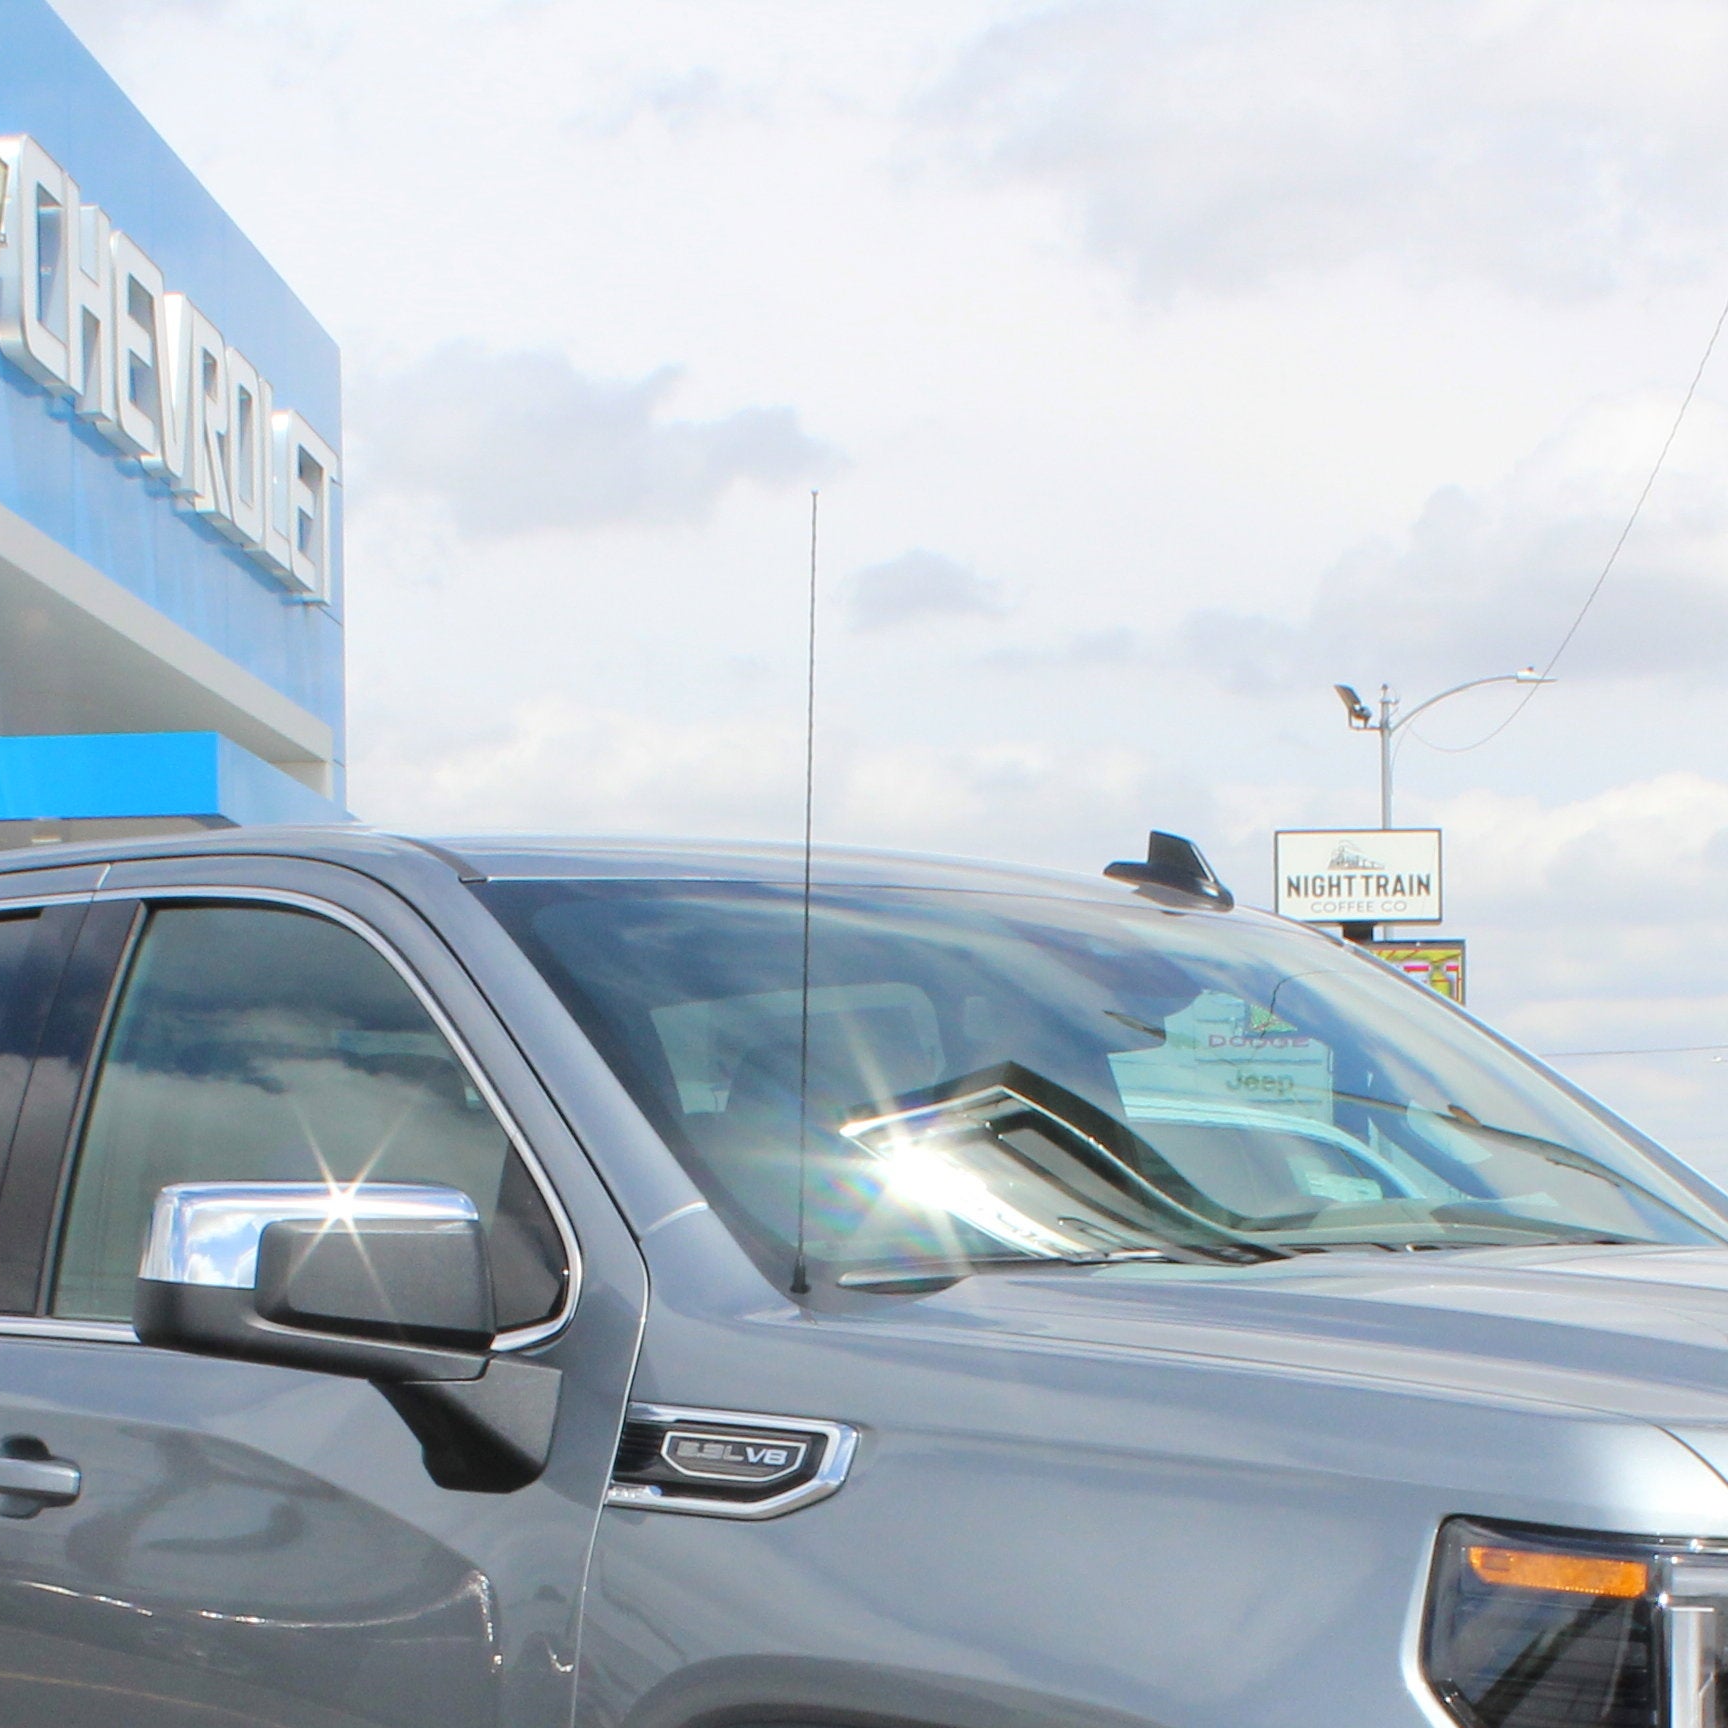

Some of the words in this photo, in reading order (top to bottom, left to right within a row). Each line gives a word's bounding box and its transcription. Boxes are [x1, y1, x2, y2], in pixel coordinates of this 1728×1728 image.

[1310, 900, 1373, 914] COFFEE
[1381, 900, 1408, 912] CO
[1225, 1069, 1294, 1095] Jeep
